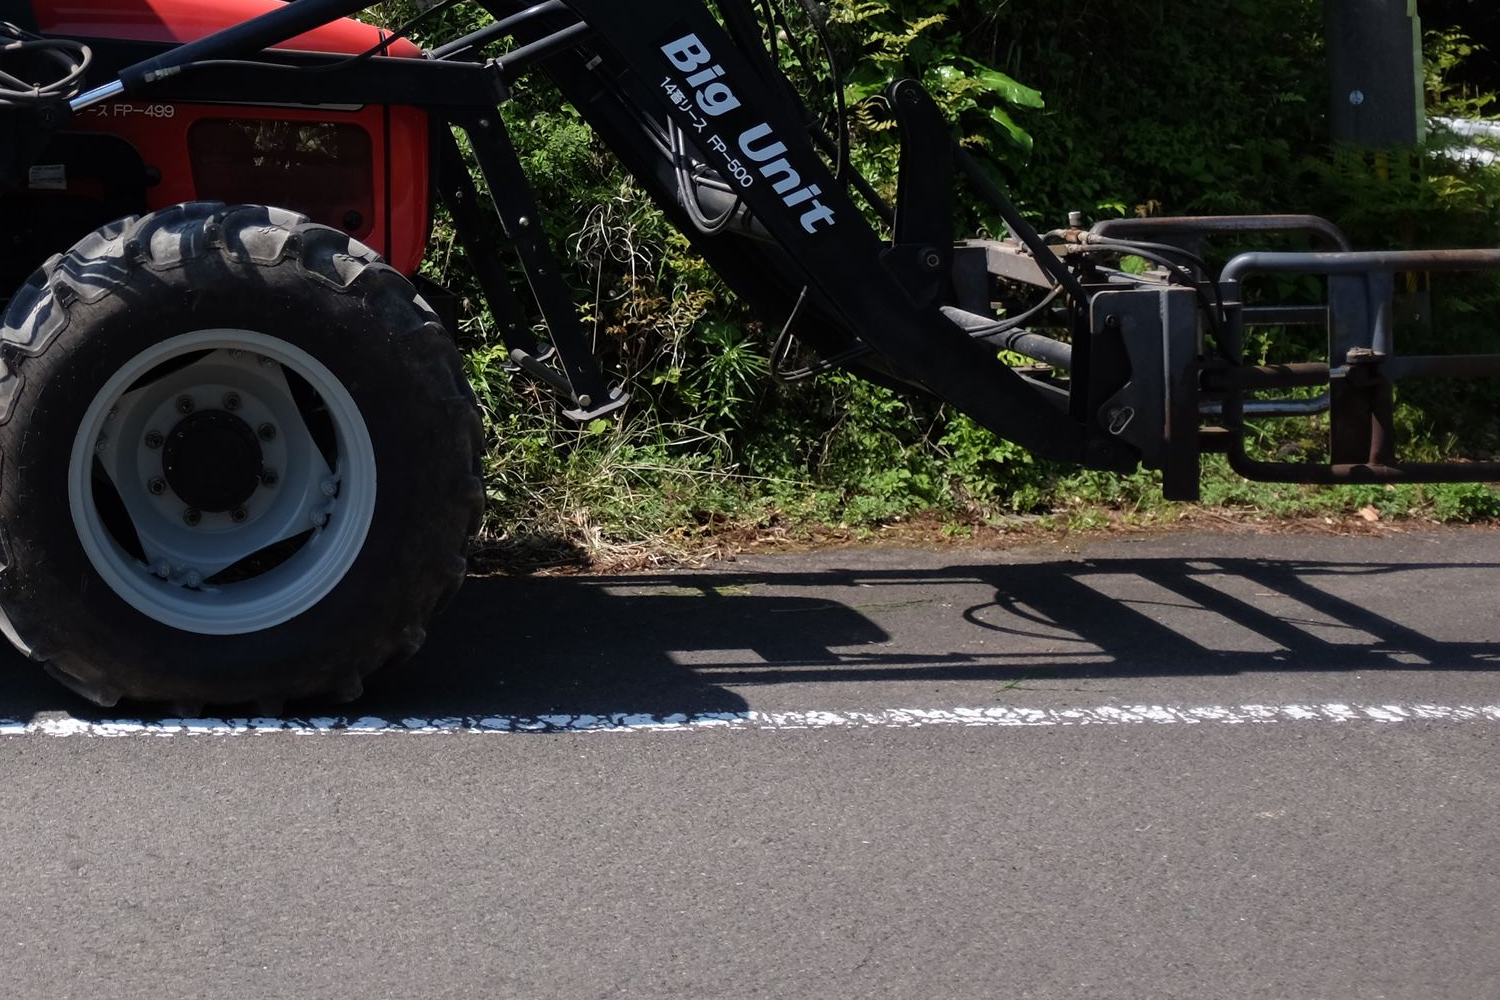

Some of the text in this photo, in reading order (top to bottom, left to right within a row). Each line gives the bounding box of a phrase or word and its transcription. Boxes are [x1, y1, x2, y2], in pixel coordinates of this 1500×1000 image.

[75, 104, 175, 118] ース FP-499
[661, 33, 836, 234] Big Unit
[706, 134, 754, 188] FP-500
